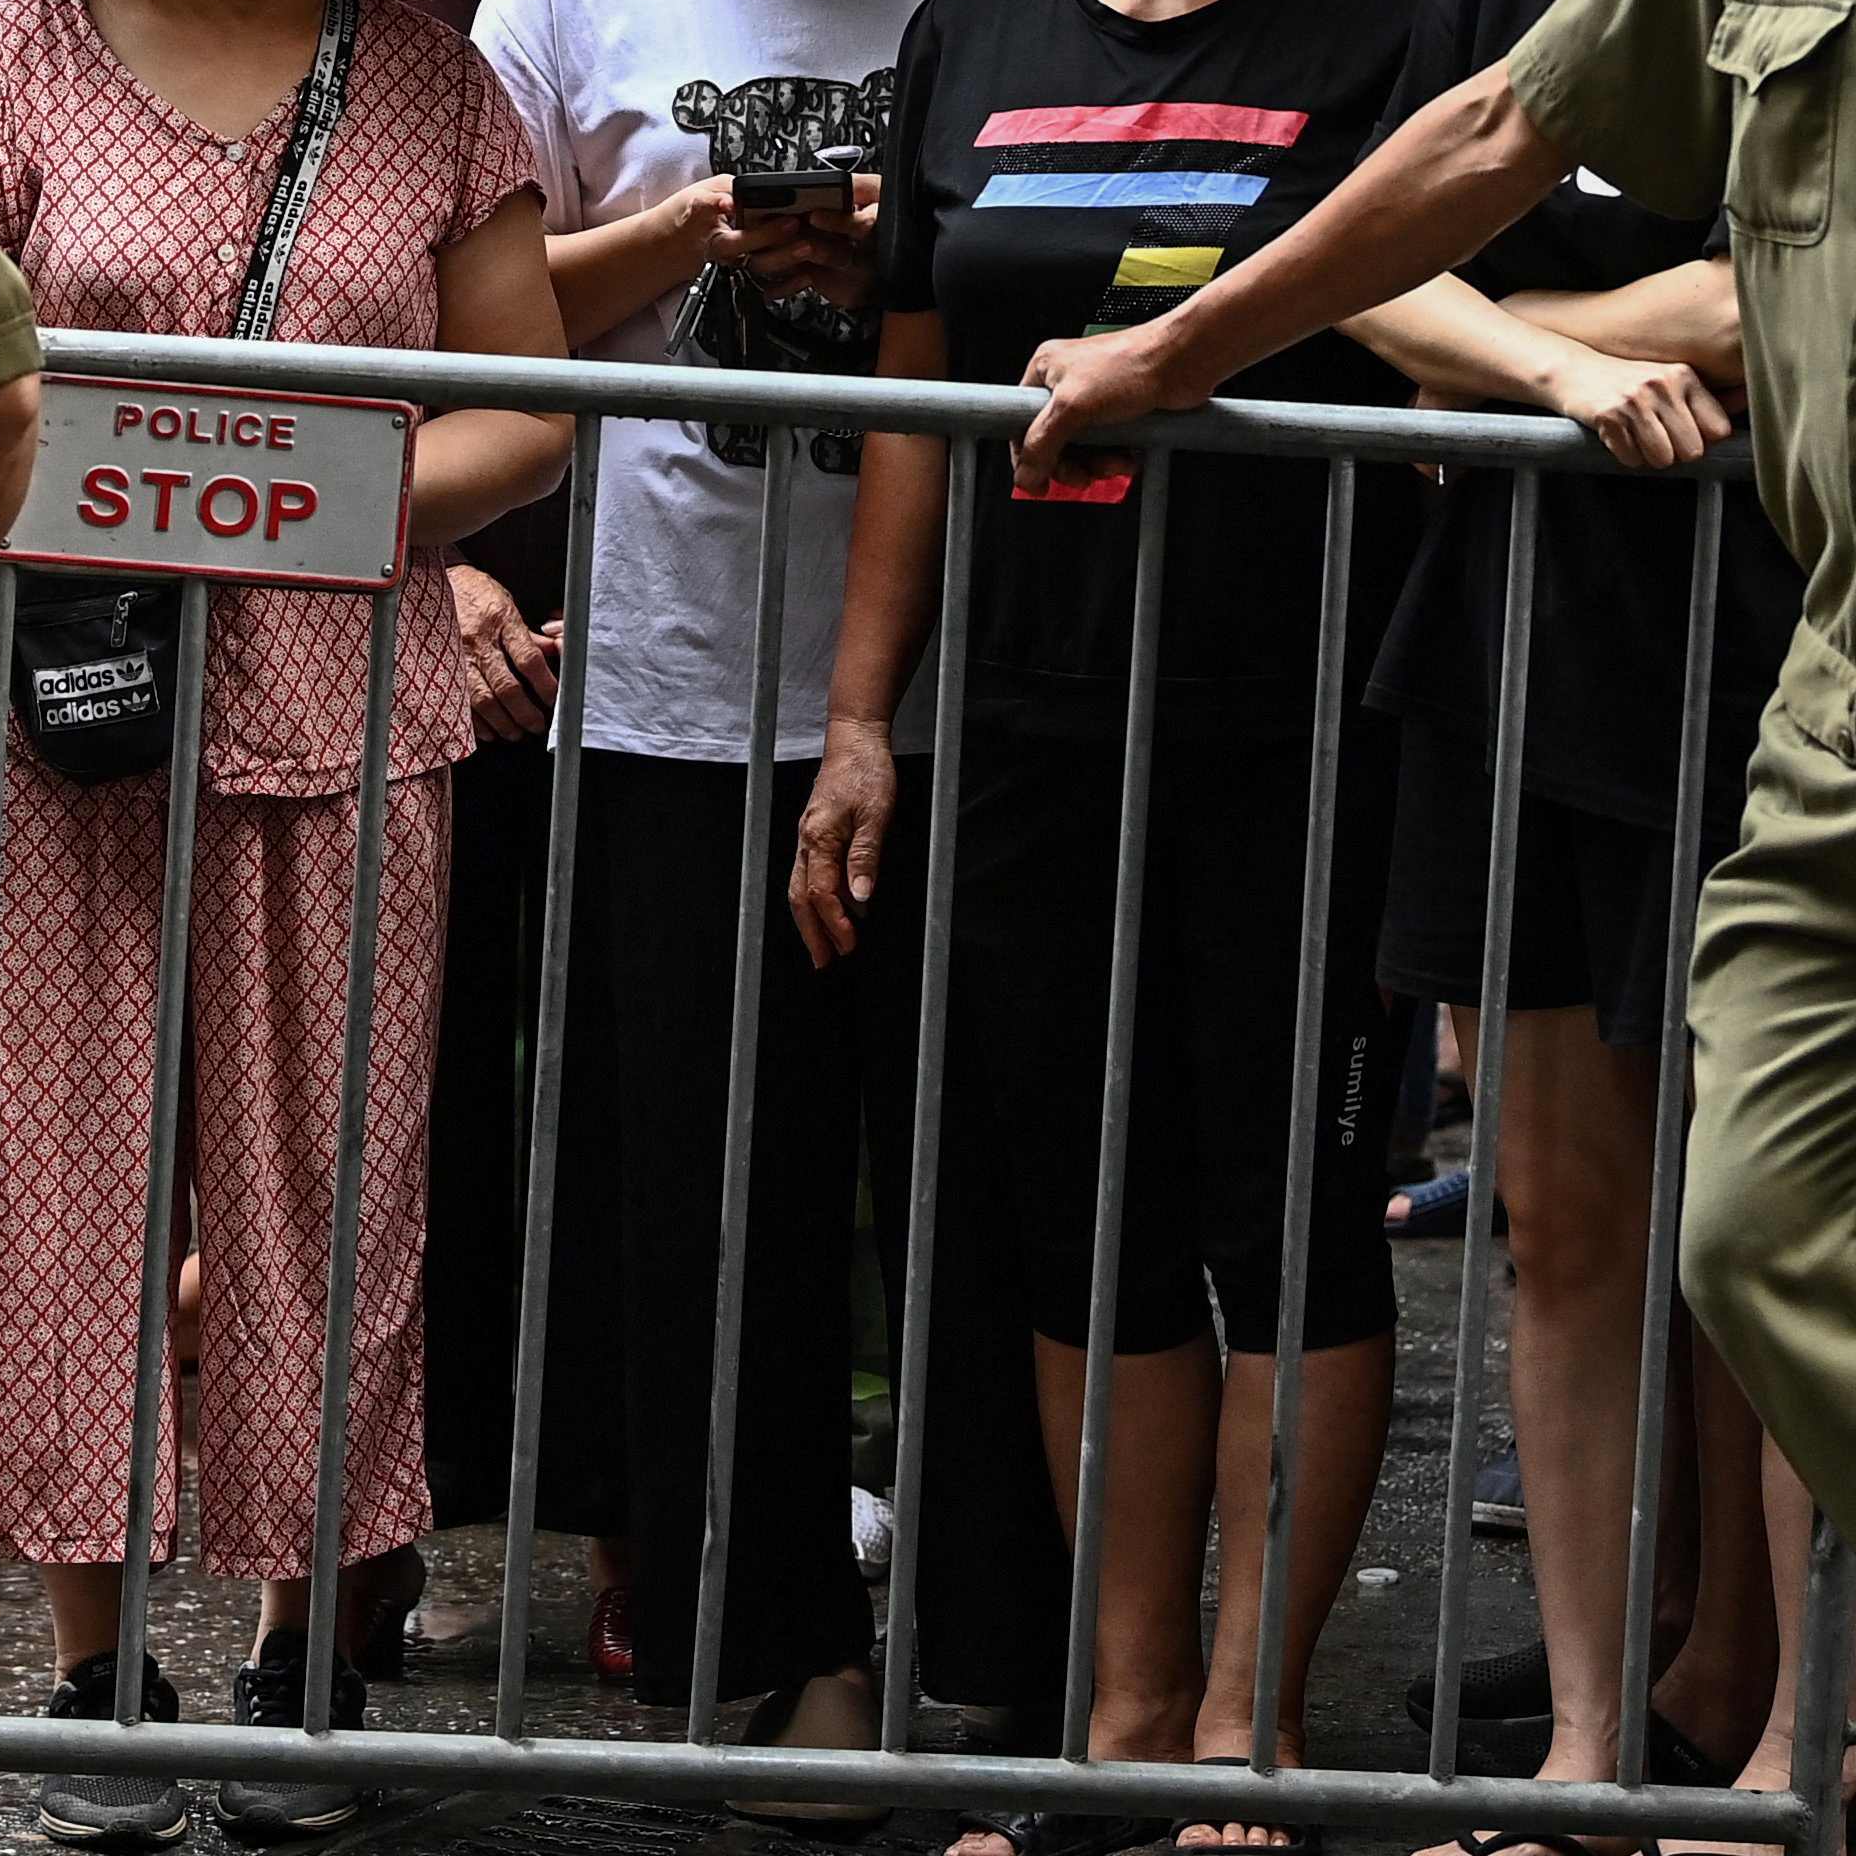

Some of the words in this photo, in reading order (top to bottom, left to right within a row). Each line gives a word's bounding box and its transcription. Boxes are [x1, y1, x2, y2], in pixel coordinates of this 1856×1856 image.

[264, 175, 292, 236] adidas
[280, 180, 308, 239] adidas
[114, 402, 297, 450] POLICE
[77, 464, 319, 541] STOP
[39, 668, 115, 695] adidas
[46, 698, 121, 725] adidas
